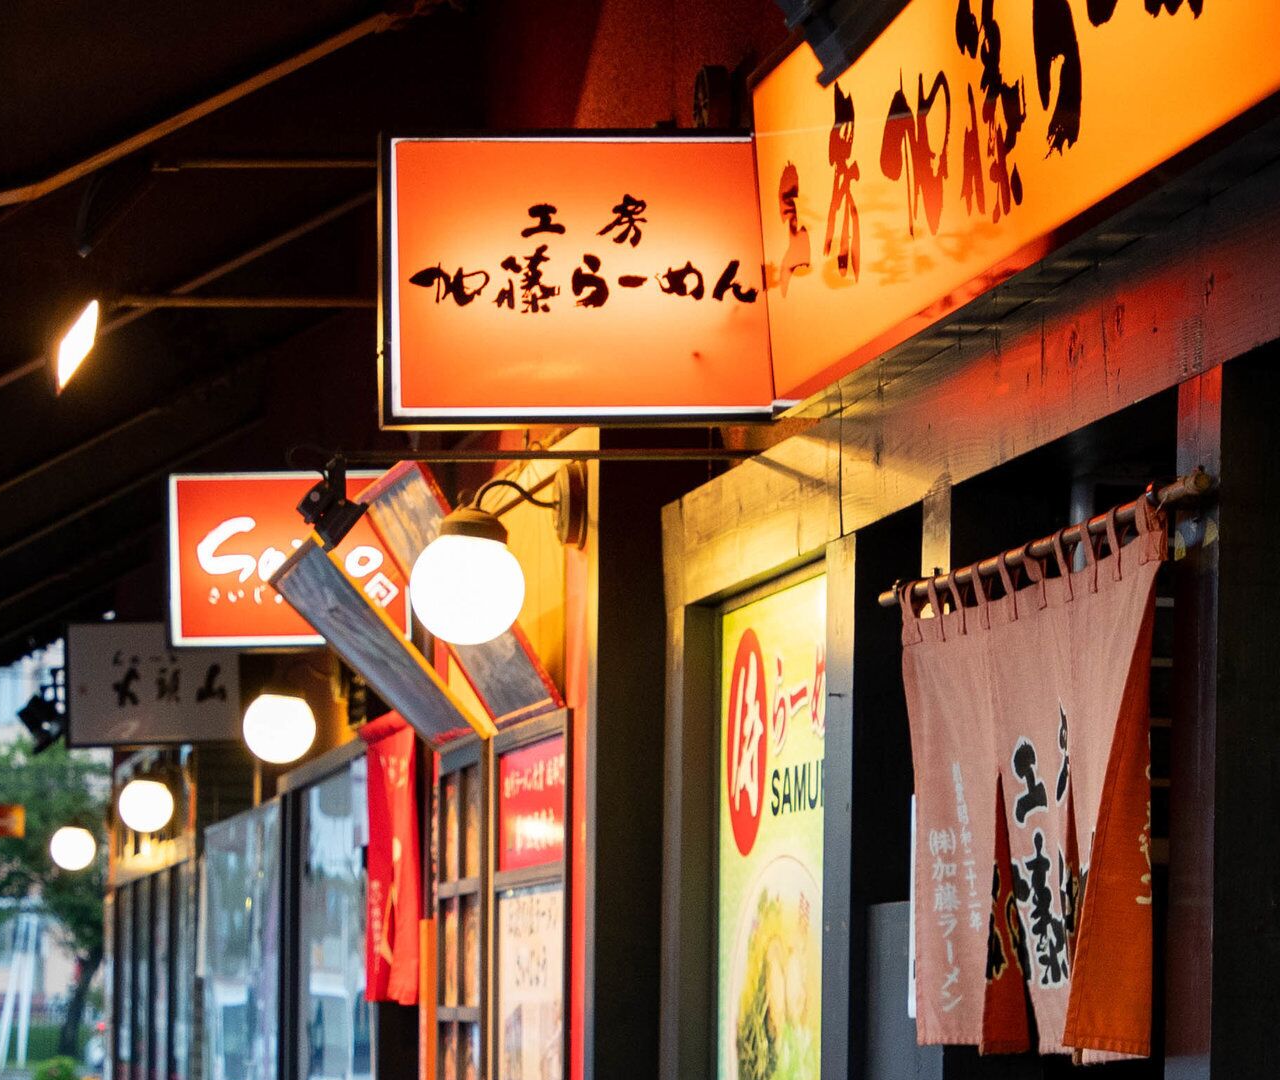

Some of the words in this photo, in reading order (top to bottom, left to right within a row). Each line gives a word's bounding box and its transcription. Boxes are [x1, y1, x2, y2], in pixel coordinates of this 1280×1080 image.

[408, 245, 758, 315] 加藤らーめん
[771, 759, 825, 817] SAMU
